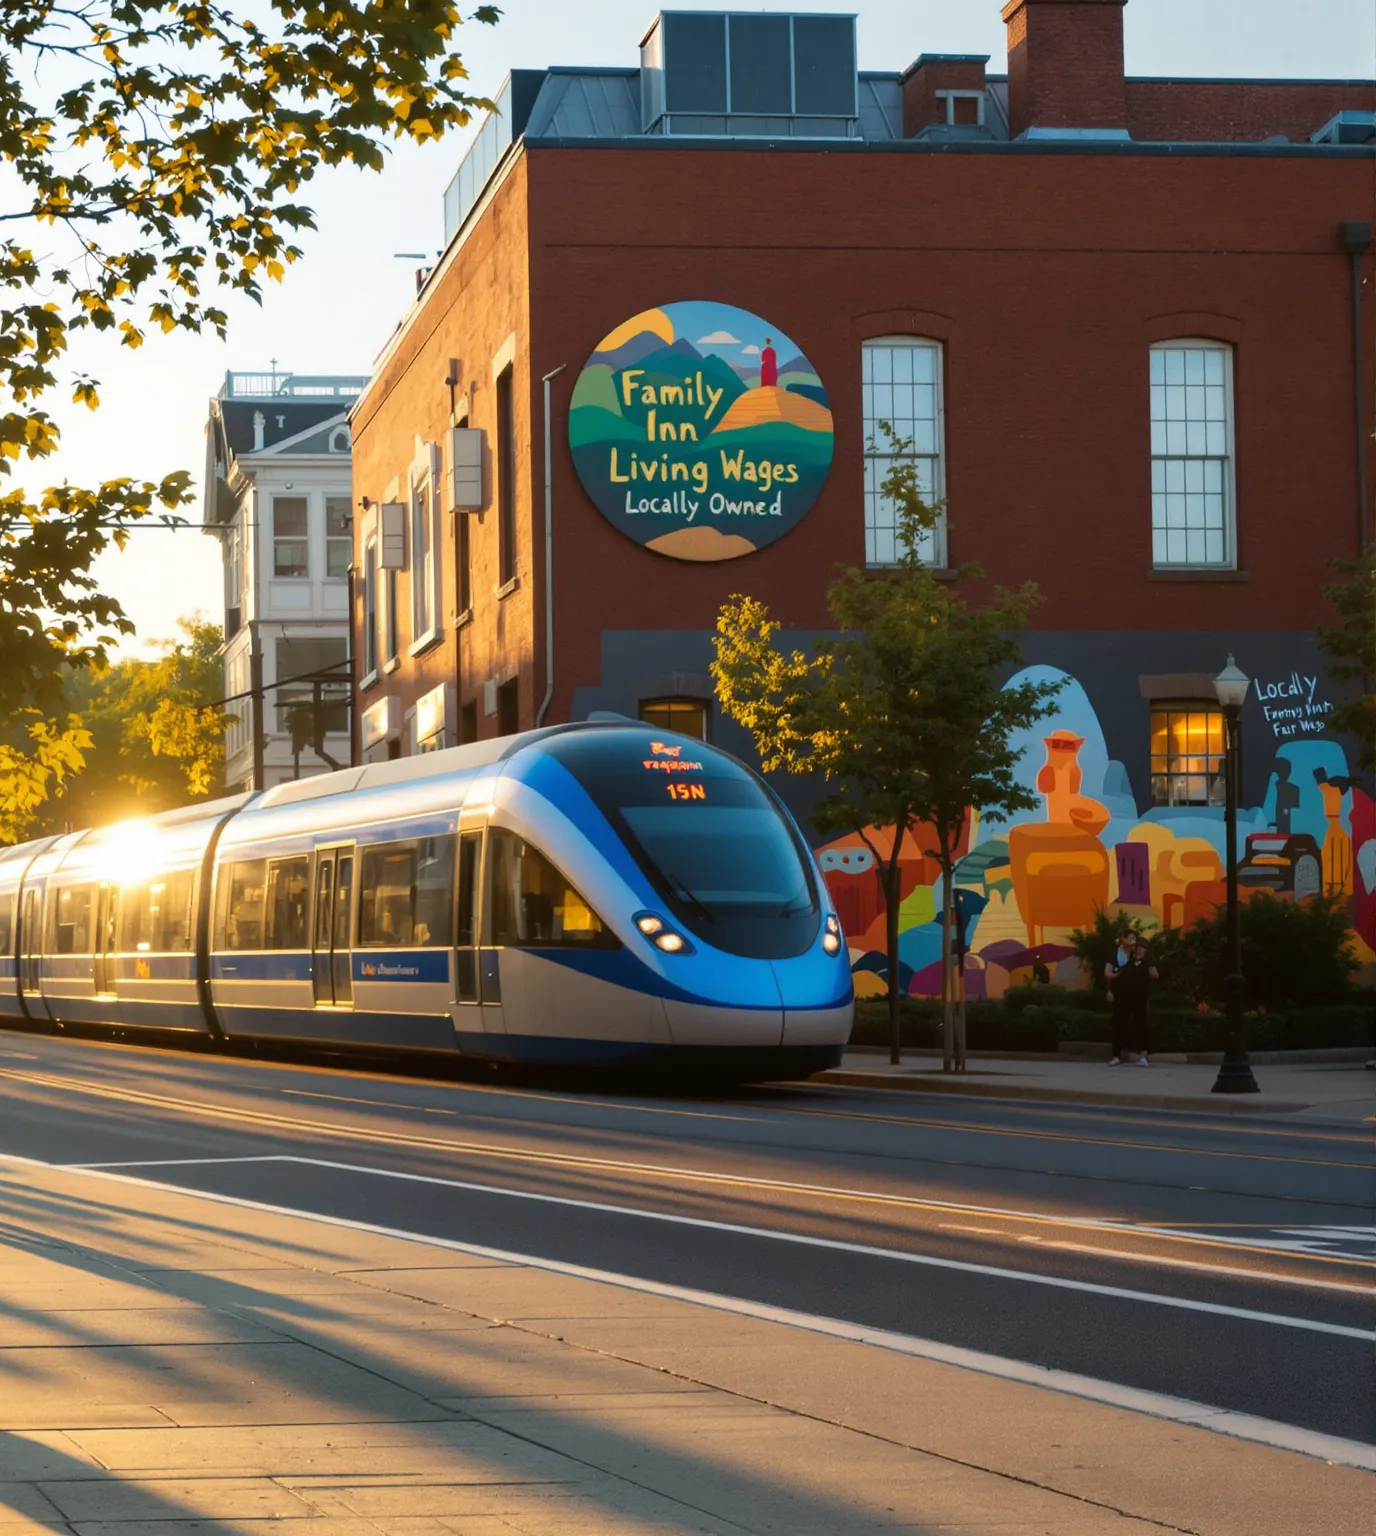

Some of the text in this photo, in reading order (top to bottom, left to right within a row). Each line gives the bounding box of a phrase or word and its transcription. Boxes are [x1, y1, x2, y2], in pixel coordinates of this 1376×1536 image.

[622, 369, 723, 419] Family
[647, 409, 698, 442] Inn
[610, 447, 799, 493] Living Wages
[625, 490, 782, 522] Locally Owned
